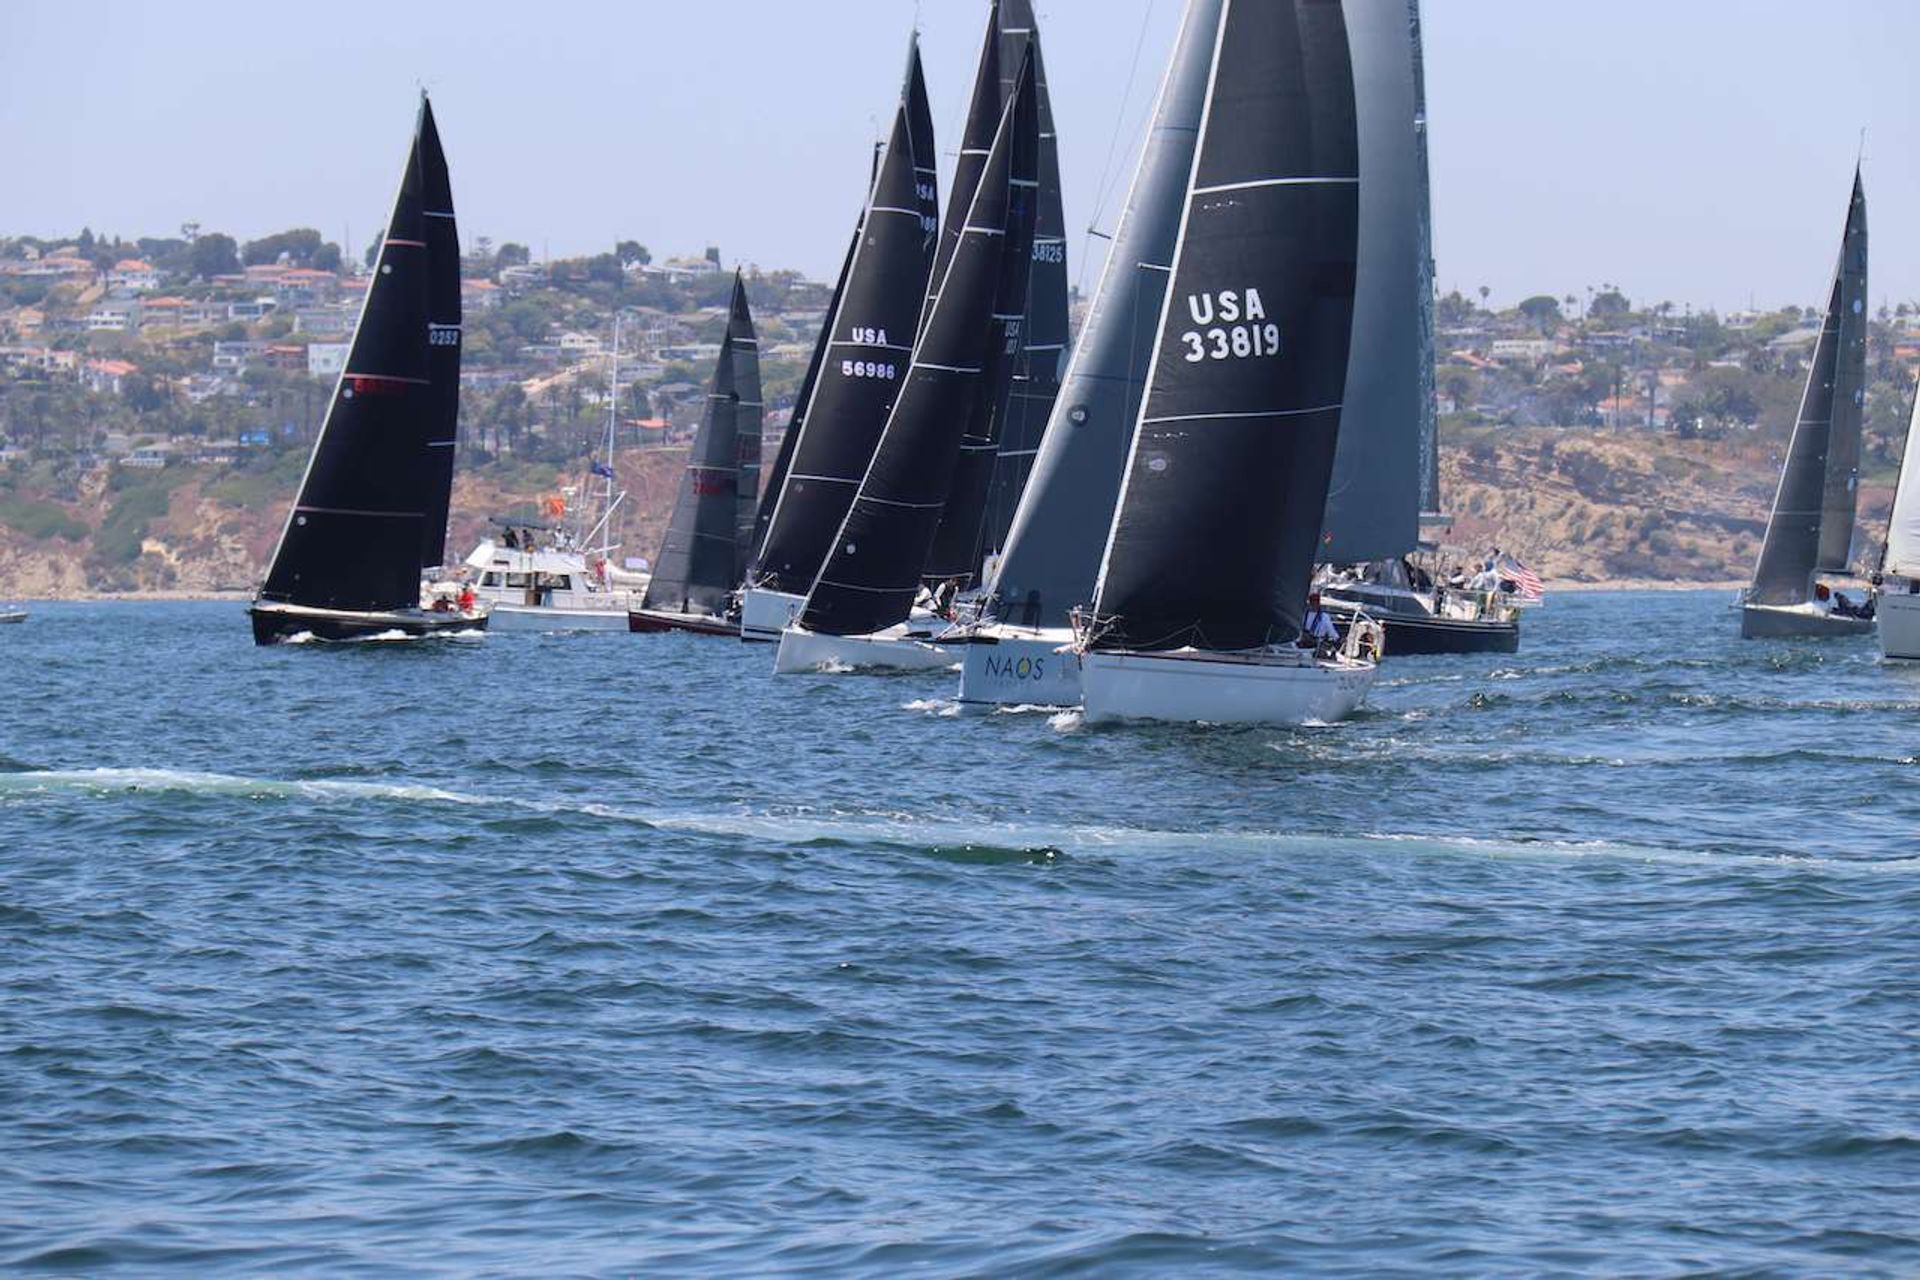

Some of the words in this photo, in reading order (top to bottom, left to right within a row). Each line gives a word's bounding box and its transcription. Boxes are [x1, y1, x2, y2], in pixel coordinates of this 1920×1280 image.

[1188, 288, 1265, 325] USA
[852, 327, 887, 346] USA
[1181, 323, 1279, 362] 33819
[842, 360, 895, 379] 56986
[985, 655, 1045, 680] NAOS
